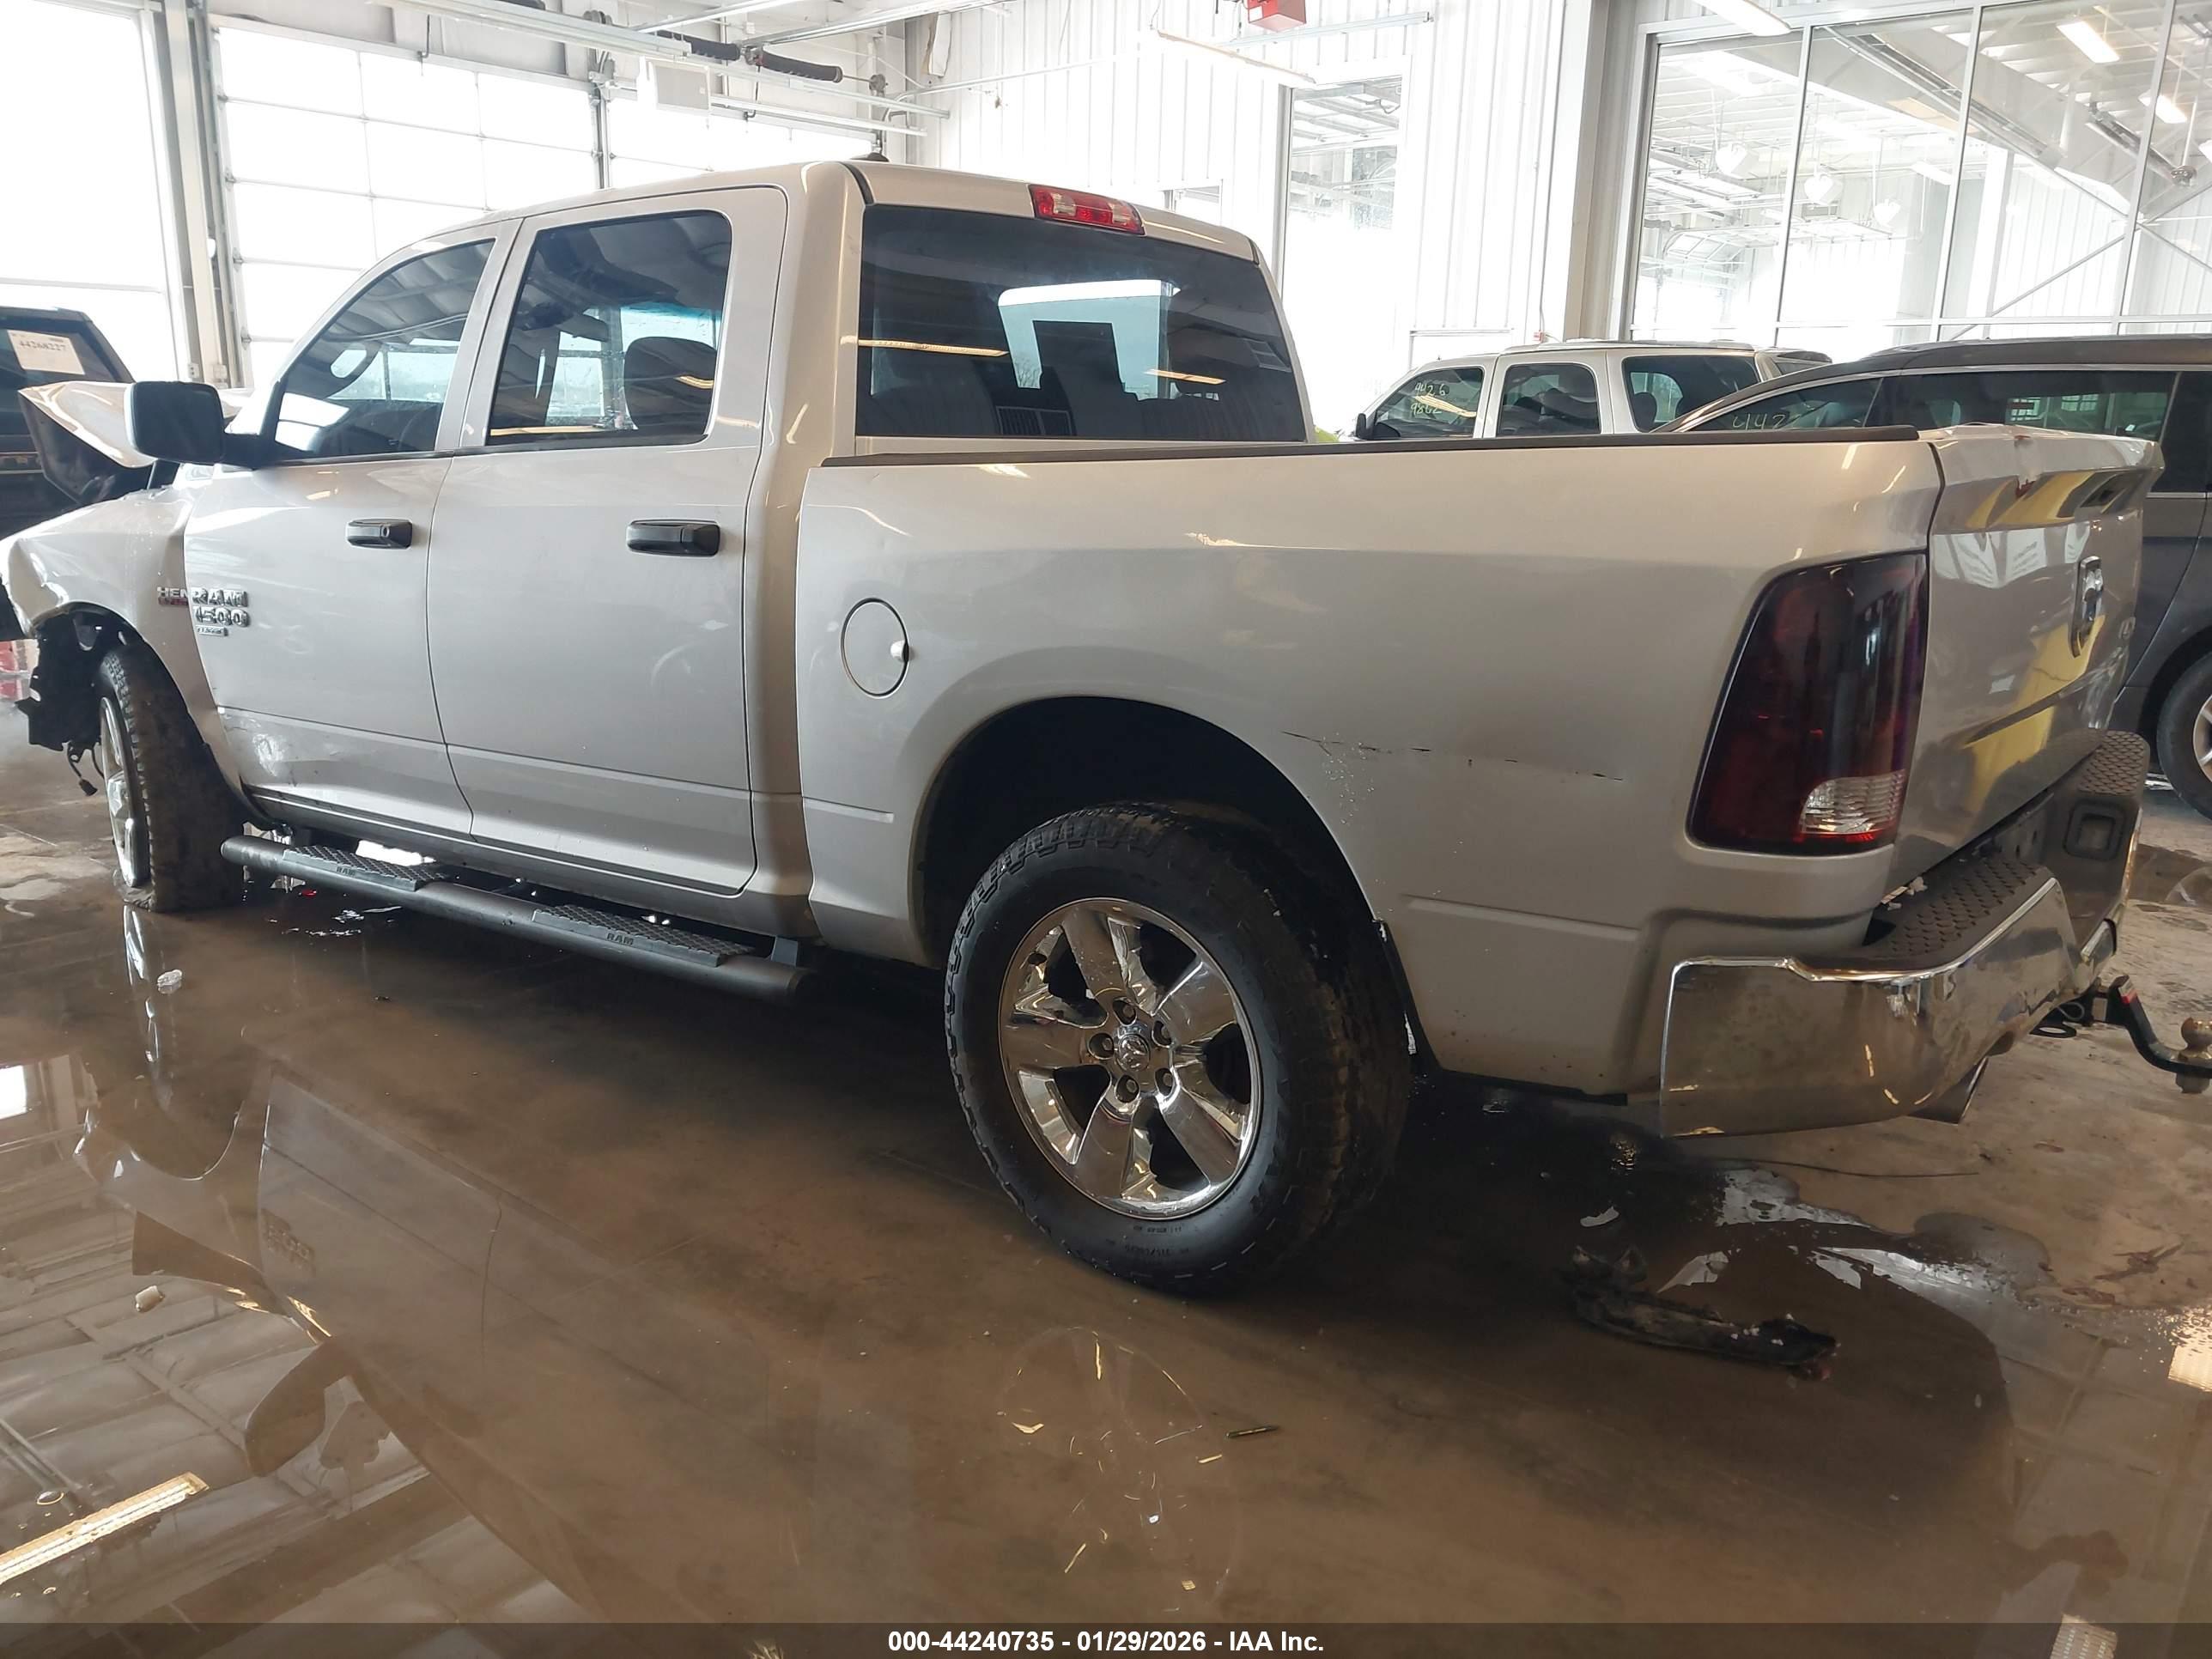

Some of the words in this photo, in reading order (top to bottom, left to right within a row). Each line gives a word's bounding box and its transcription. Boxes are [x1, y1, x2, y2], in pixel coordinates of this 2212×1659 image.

[191, 586, 249, 608] RAM
[193, 605, 251, 628] 1500
[336, 866, 356, 877] RAM
[606, 933, 635, 945] RAM
